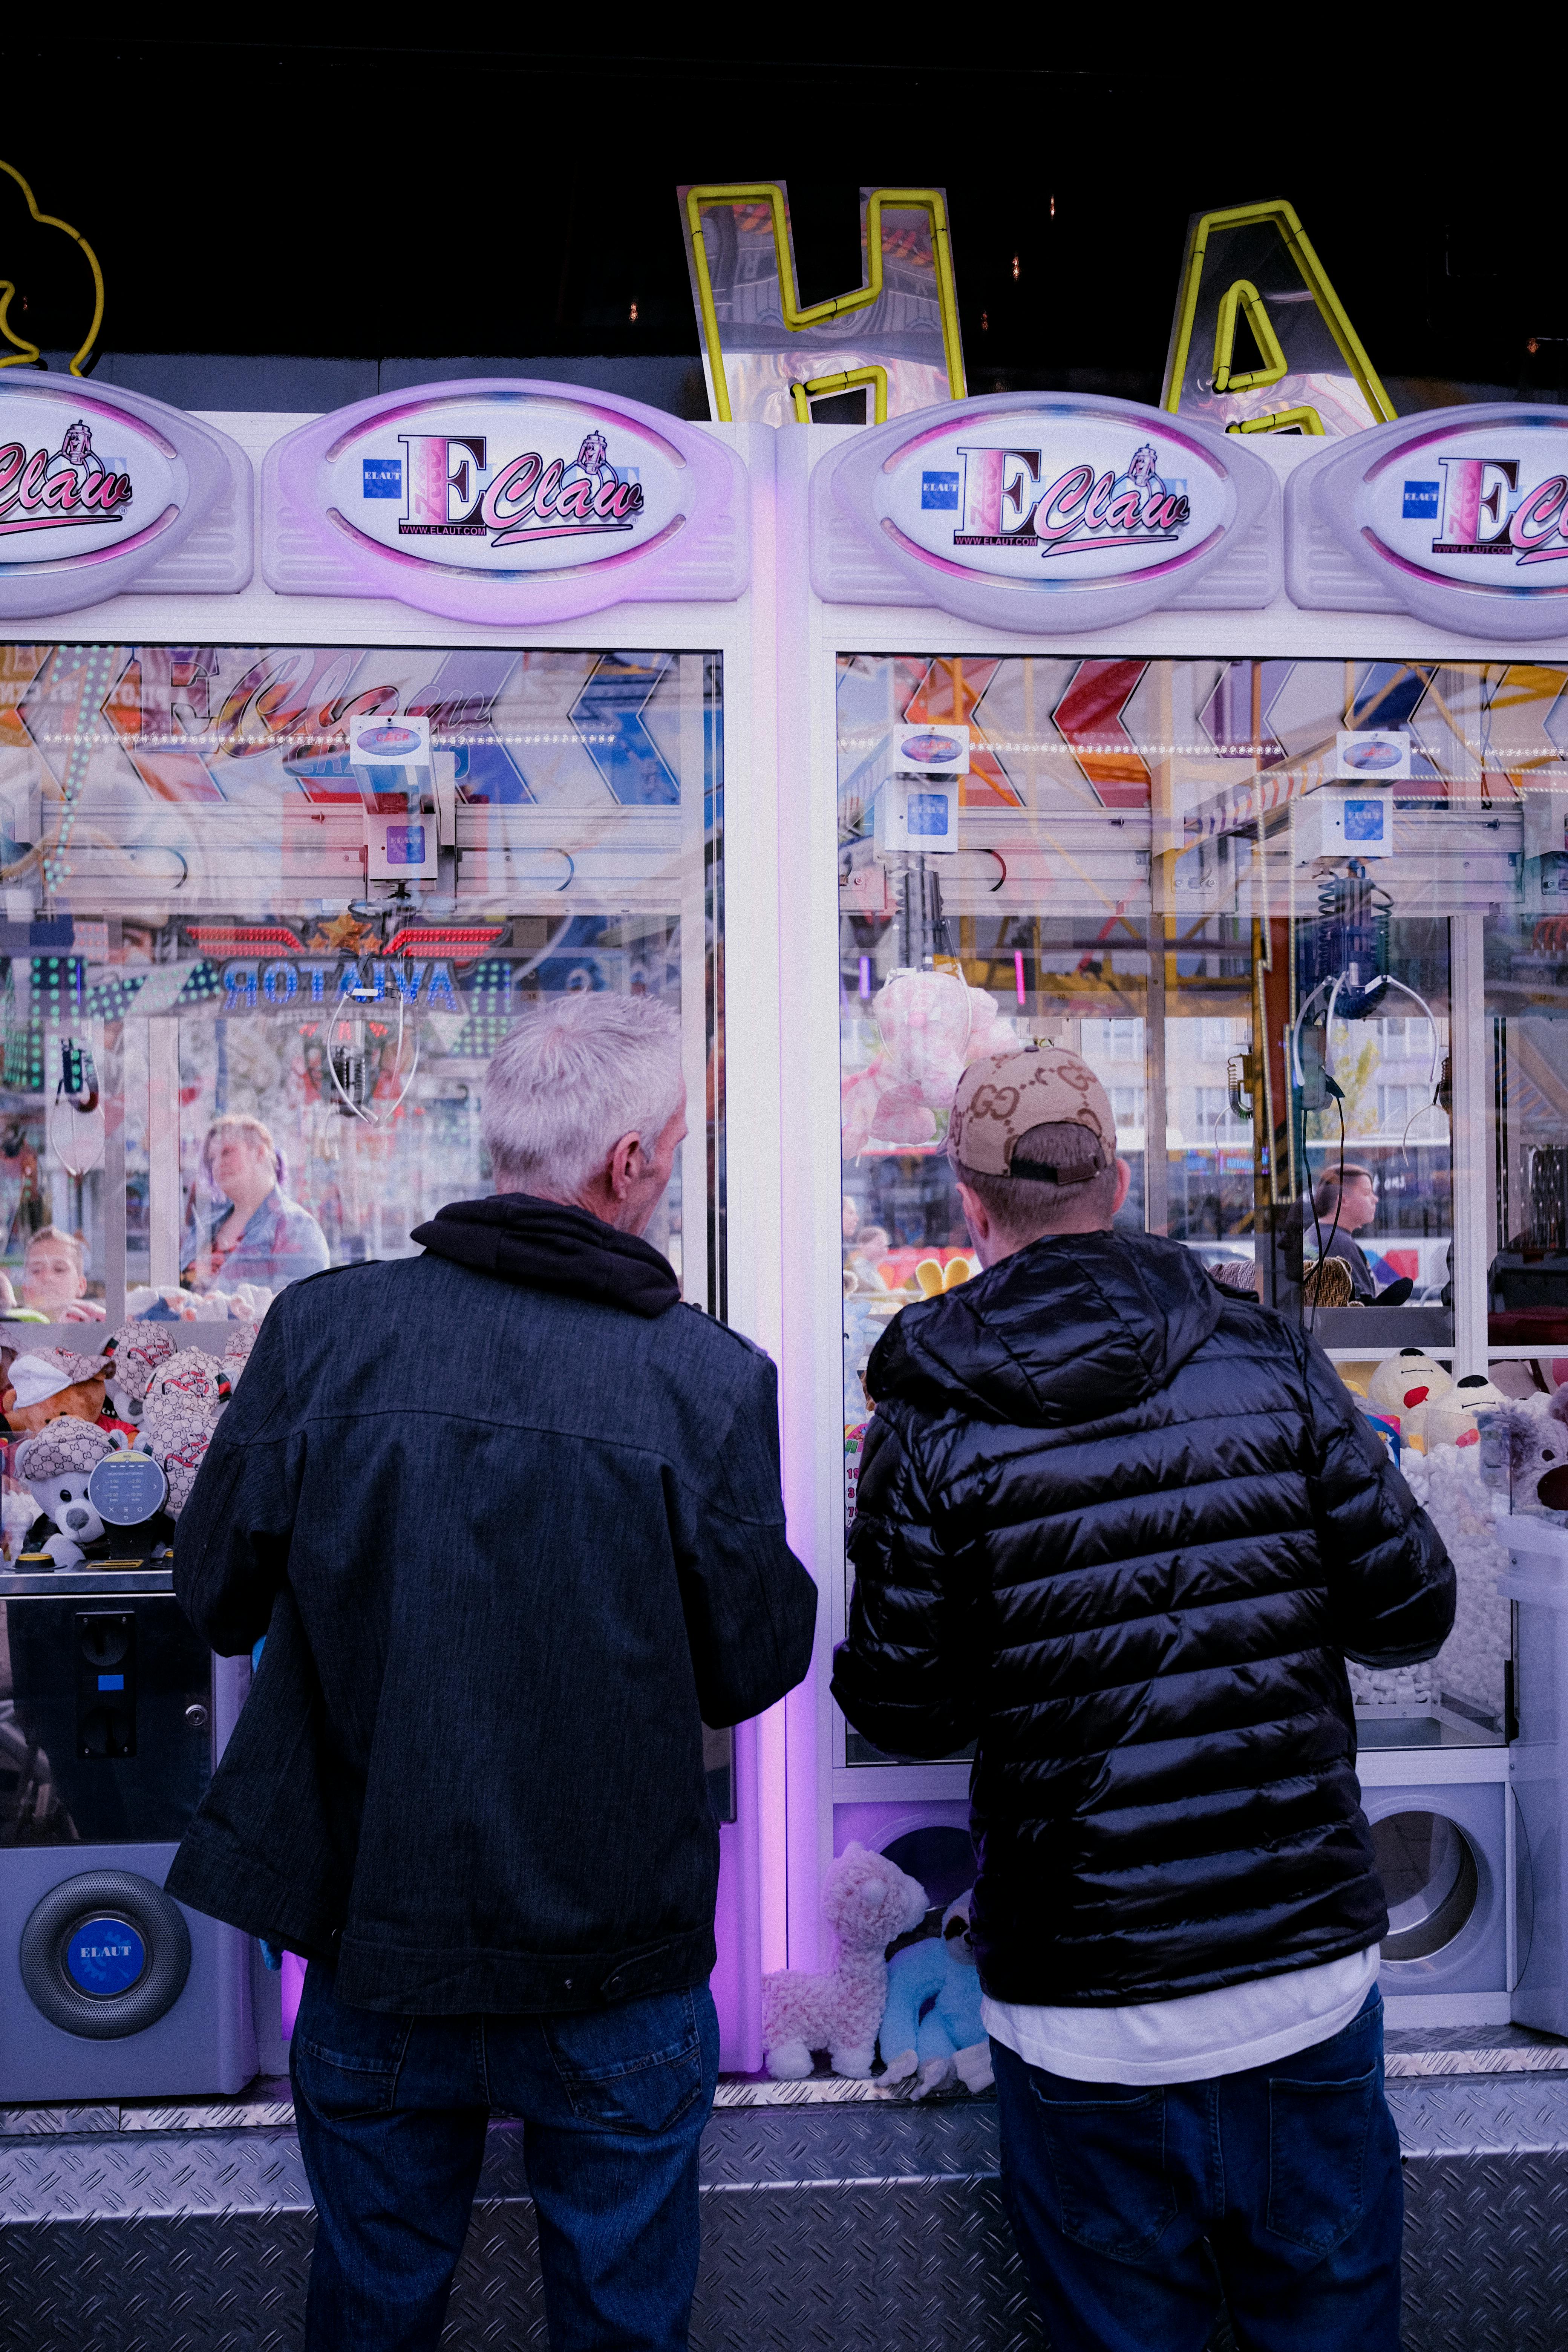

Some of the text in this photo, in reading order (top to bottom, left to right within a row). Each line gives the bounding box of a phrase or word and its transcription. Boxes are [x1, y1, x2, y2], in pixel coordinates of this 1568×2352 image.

[364, 471, 401, 480] ELAUT
[398, 434, 644, 529] E Claw
[923, 483, 958, 492] ELAUT
[954, 447, 1190, 540] E Claw
[1404, 492, 1438, 502] ELAUT
[401, 526, 485, 536] WWW.ELAUT.COM
[956, 537, 1037, 546] WWW.ELAUT.COM
[1434, 545, 1513, 554] WWW.ELAUT.COM
[80, 1946, 132, 1958] ELAUT
